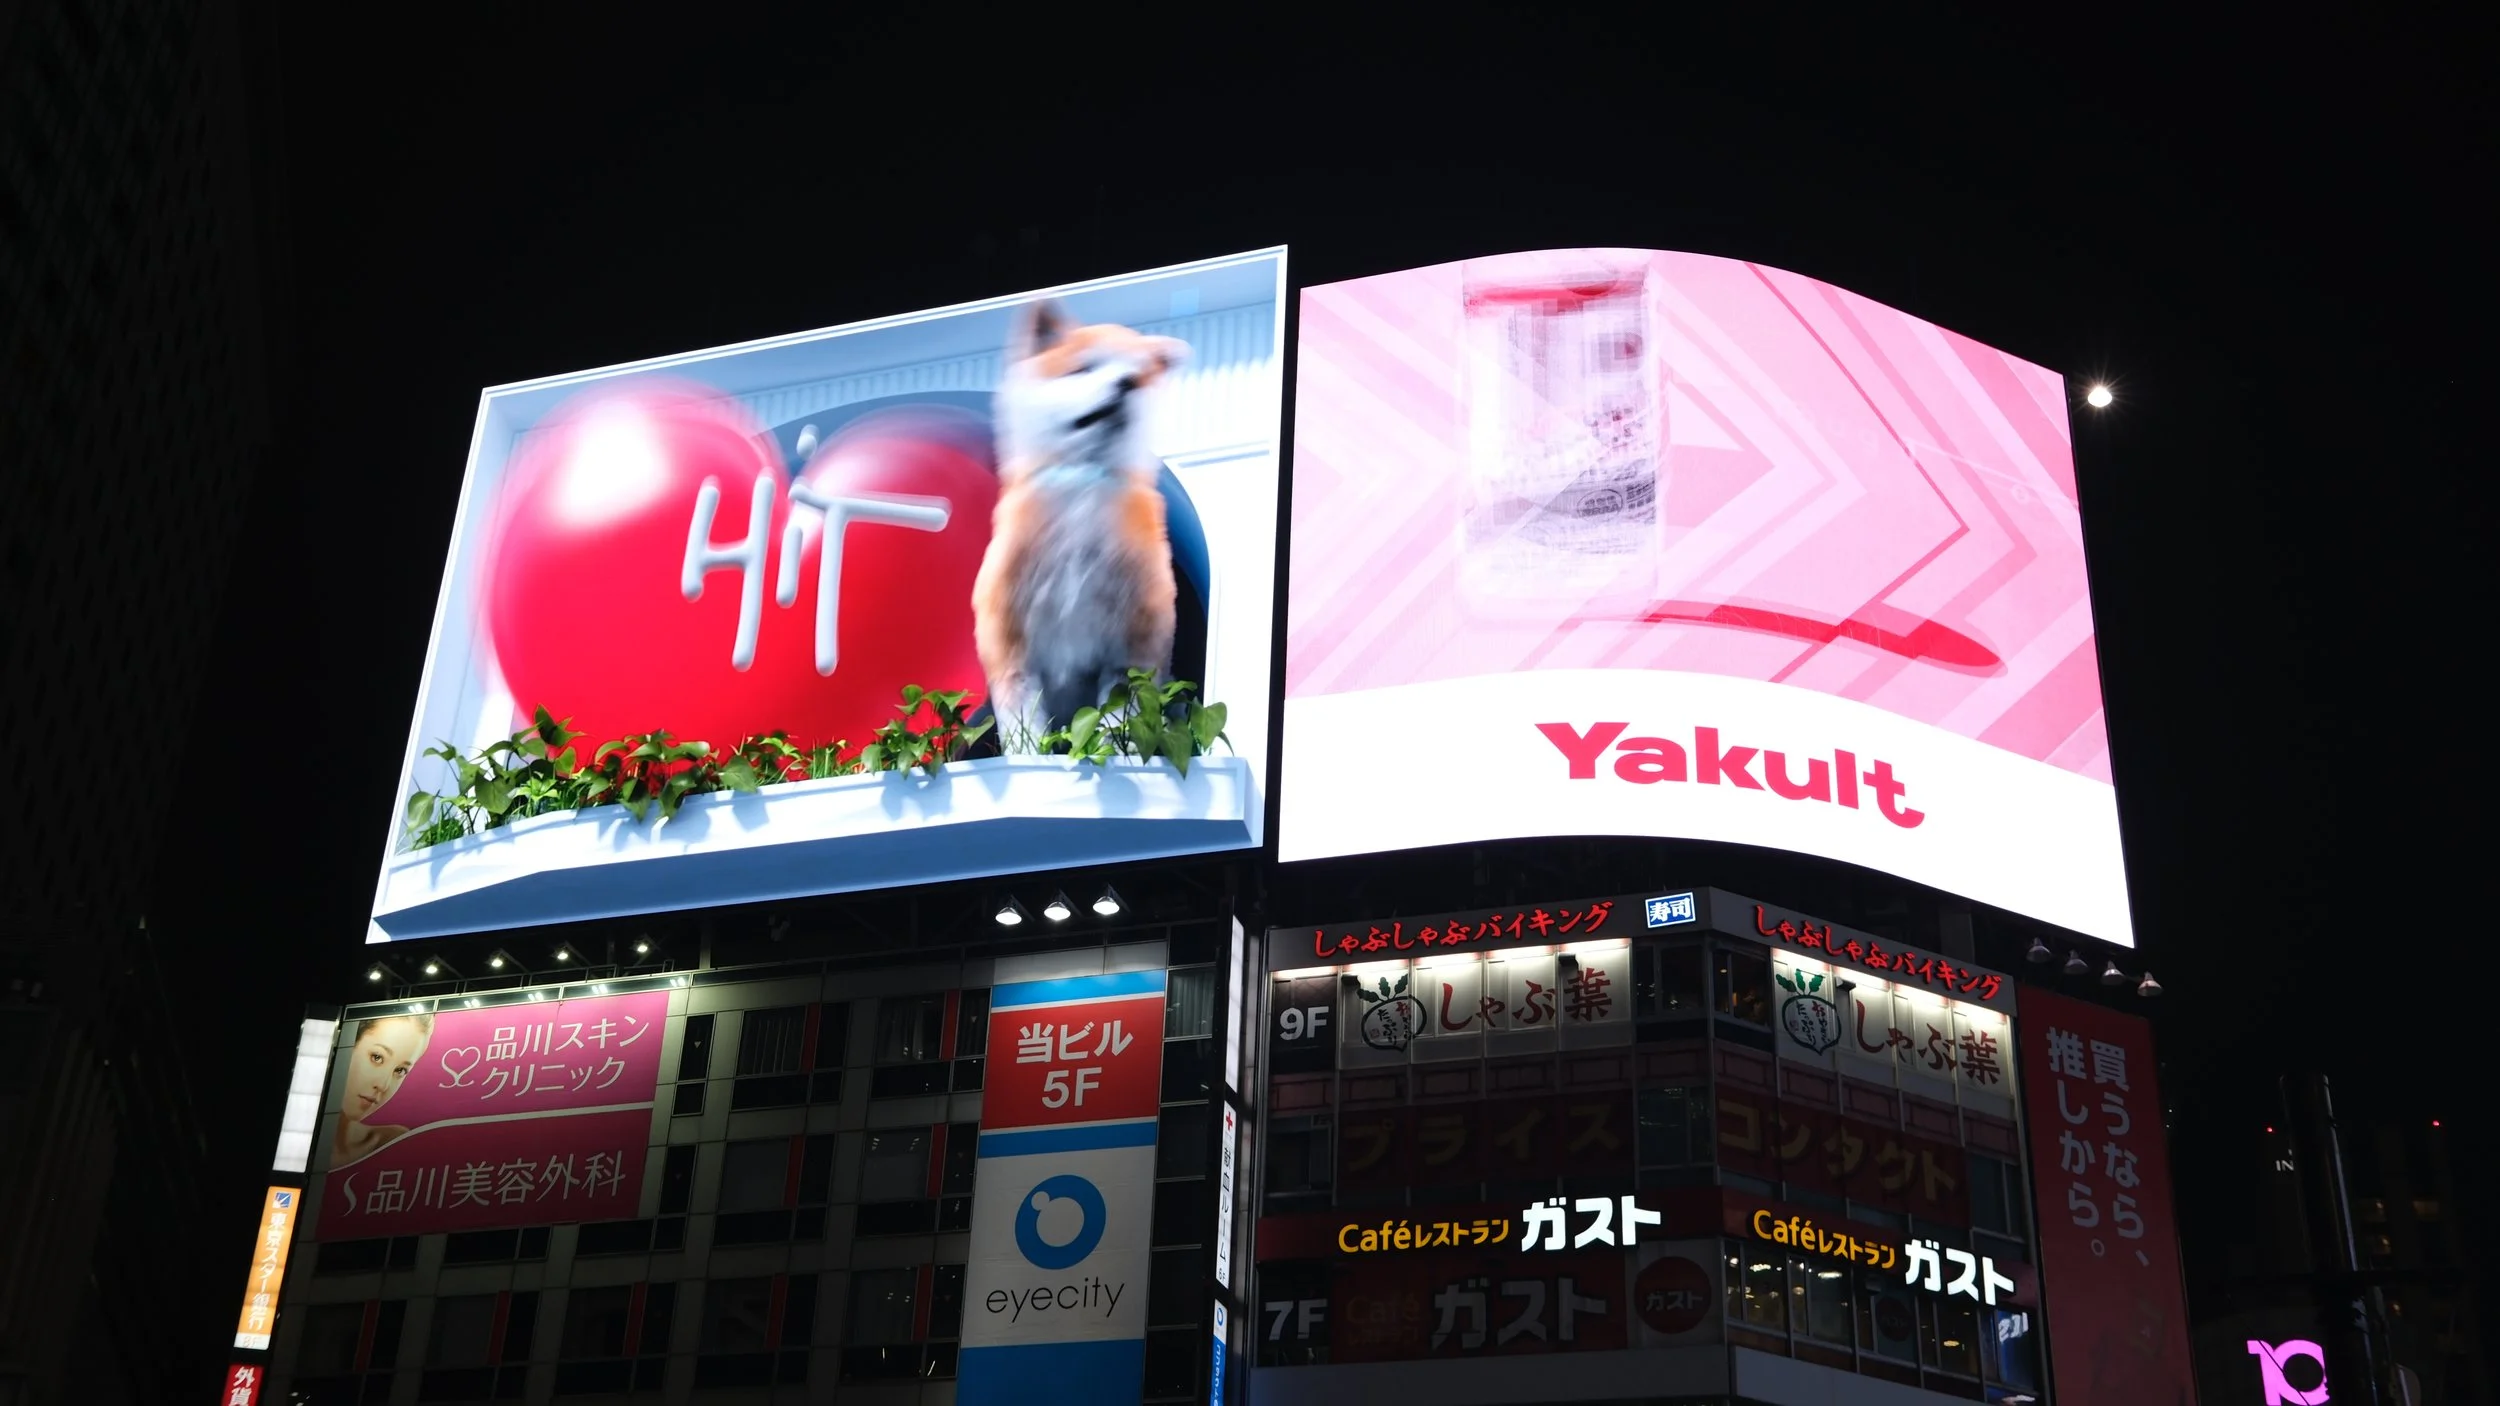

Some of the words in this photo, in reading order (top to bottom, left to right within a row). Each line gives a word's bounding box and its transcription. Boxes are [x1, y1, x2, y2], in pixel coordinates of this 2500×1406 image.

[1534, 721, 1925, 829] Yakult
[1313, 900, 1615, 958] しゃぶしゃぶバイキング
[1650, 898, 1692, 922] 寿司
[1753, 904, 2003, 1001] しゃぶしゃぶバイキング
[1279, 1006, 1329, 1041] 9F
[1440, 968, 1612, 1032] しゃぶ葉
[485, 1015, 649, 1061] 品川スキン
[1016, 1019, 1133, 1064] 当ビル
[1855, 999, 2000, 1086] しゃぶ葉
[480, 1057, 625, 1100] クリニック
[1042, 1067, 1102, 1109] 5F
[1343, 1103, 1621, 1172] プライス
[1718, 1098, 1957, 1201] コンタクト
[2046, 1026, 2105, 1257] 推しから。
[2090, 1039, 2150, 1267] 買うなら、
[365, 1150, 626, 1215] 品川美容外科
[1521, 1195, 1662, 1253] ガスト
[248, 1212, 287, 1331] 東京スター銀行
[986, 1276, 1125, 1324] eyecity
[1645, 1290, 1704, 1311] ガスト
[1905, 1239, 2015, 1306] ガスト
[1265, 1300, 1327, 1341] 7F
[1432, 1276, 1607, 1351] ガスト
